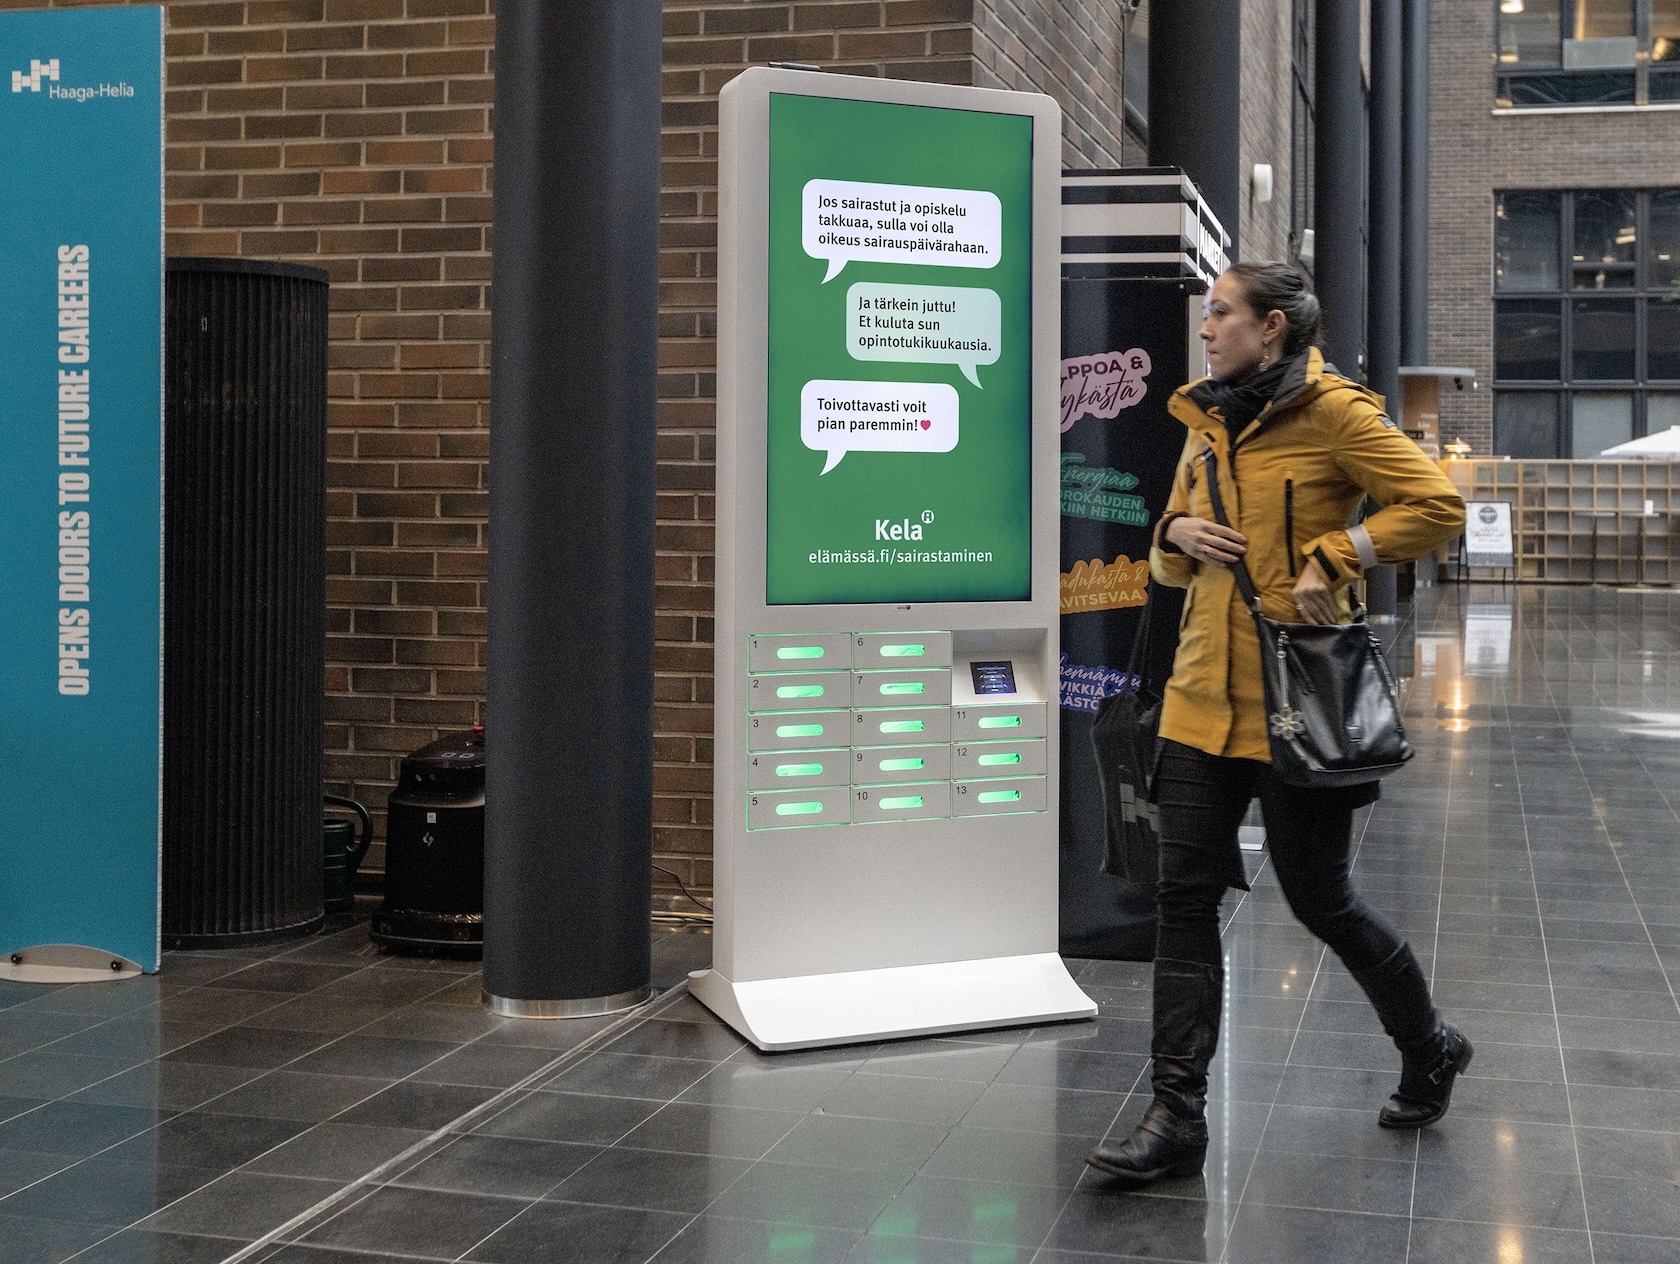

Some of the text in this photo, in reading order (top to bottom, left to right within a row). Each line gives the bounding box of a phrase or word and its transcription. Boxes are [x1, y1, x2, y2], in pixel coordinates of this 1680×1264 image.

[49, 82, 134, 102] Haaga-Helia
[818, 194, 967, 217] Jos sairastut ja opiskelu
[818, 213, 954, 234] takkuaa, sulla voi olla
[818, 233, 989, 254] oikeus sairauspäivärahaan.
[858, 296, 956, 315] Ja tärkein juttu!
[859, 315, 940, 331] Et kuluta sun
[858, 334, 992, 352] opintotukikuukausia.
[1061, 356, 1144, 381] PPOA &
[817, 397, 927, 413] Toivottavasti voit
[1061, 369, 1139, 425] ykästä
[817, 417, 918, 433] pian paremmin!
[58, 244, 90, 696] OPENS DOORS TO FUTURE CAREERS
[1061, 490, 1141, 511] ROKAUDEN
[1090, 505, 1147, 523] HETKIIN
[875, 518, 923, 541] Kela
[808, 548, 993, 566] elämässä.fi/sairastaminen
[1134, 566, 1145, 582] &
[753, 640, 758, 649] 1
[857, 637, 864, 647] 6
[752, 679, 759, 689] 2
[857, 675, 863, 685] 7
[856, 714, 863, 724] 8
[956, 710, 966, 720] 11
[752, 718, 759, 729] 3
[856, 752, 863, 762] 9
[956, 747, 967, 757] 12
[752, 757, 759, 767] 4
[856, 791, 868, 801] 10
[956, 785, 967, 795] 13
[751, 796, 758, 806] 5
